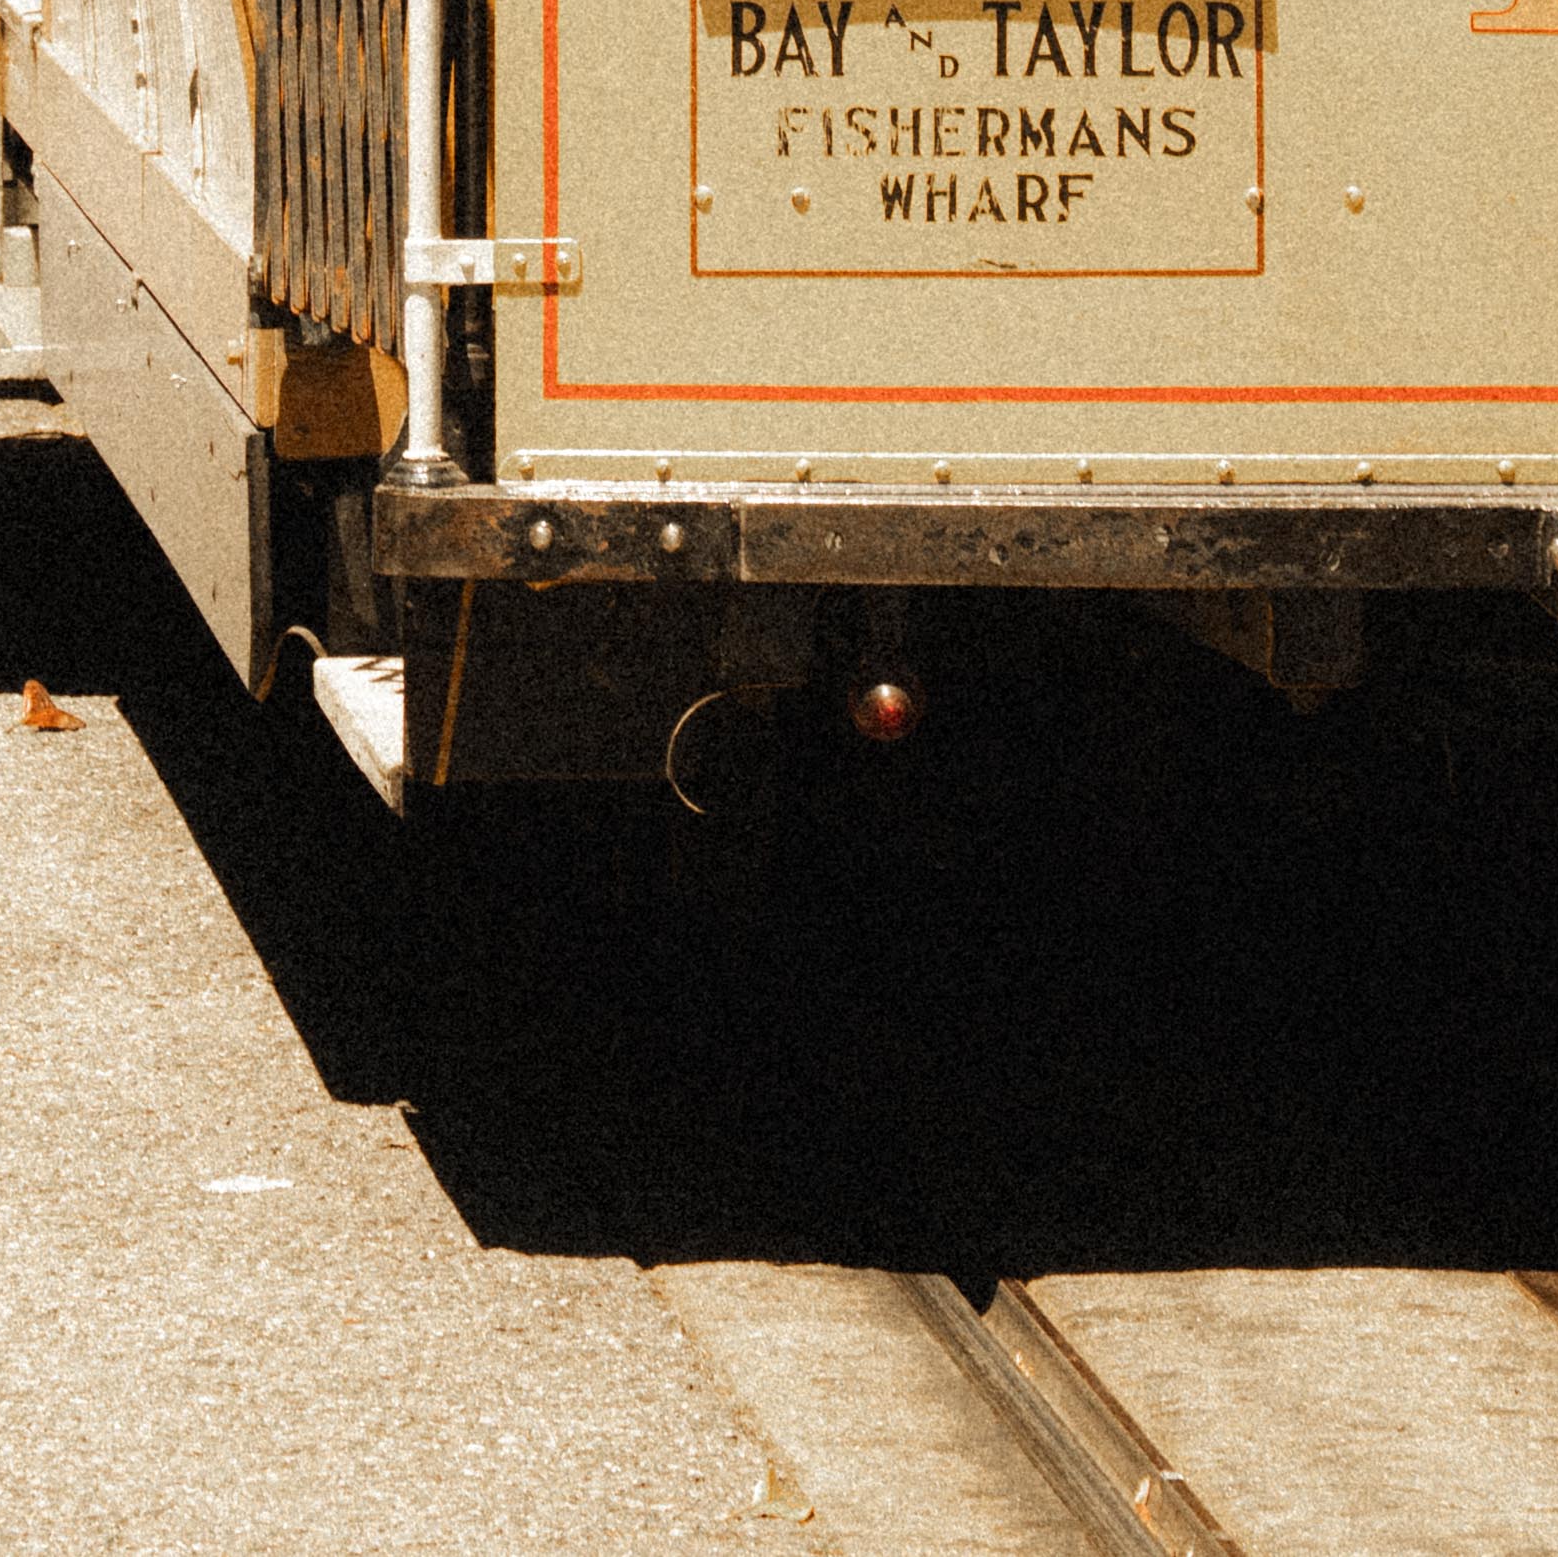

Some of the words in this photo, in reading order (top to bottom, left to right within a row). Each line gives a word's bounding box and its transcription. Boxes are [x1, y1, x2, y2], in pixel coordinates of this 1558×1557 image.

[730, 0, 854, 78] BAY
[884, 3, 961, 79] AND
[982, 0, 1244, 78] TAYLOR
[775, 107, 1198, 158] FISHERMANS
[880, 172, 1094, 224] WHARF
